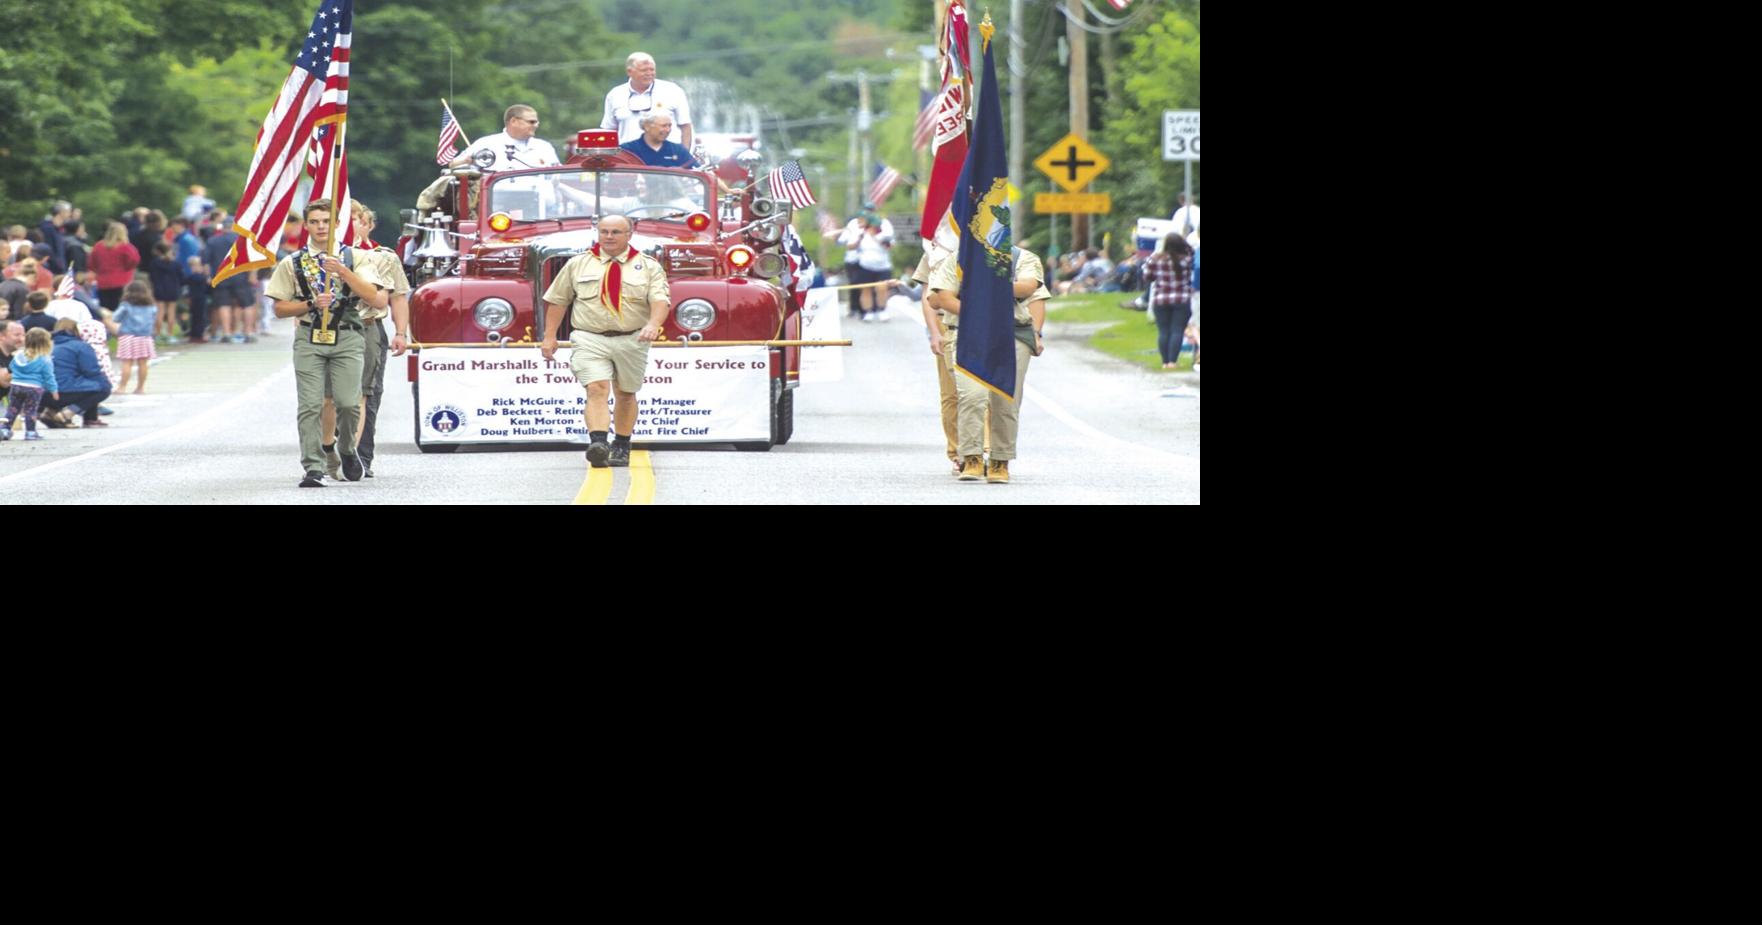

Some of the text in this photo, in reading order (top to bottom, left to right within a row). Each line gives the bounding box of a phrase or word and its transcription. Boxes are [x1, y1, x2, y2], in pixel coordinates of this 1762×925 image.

[1167, 115, 1200, 124] SPEE
[1171, 127, 1200, 135] LIMI
[422, 359, 766, 371] Grand Marshalls Tha Your Service to
[516, 373, 539, 384] the
[492, 398, 516, 406] Rick
[520, 397, 566, 406] McGuire
[651, 397, 697, 407] Manager
[476, 408, 498, 417] Deb
[502, 407, 543, 416] Beckett
[554, 407, 585, 415] Retire
[639, 407, 712, 416] erk/Treasurer
[510, 417, 531, 426] Ken
[534, 417, 575, 425] Morton
[651, 417, 680, 426] Chief
[480, 428, 509, 437] Doug
[512, 427, 553, 436] Hulbert
[565, 426, 590, 435] Retir
[657, 427, 677, 435] Fire
[680, 427, 710, 435] Chief
